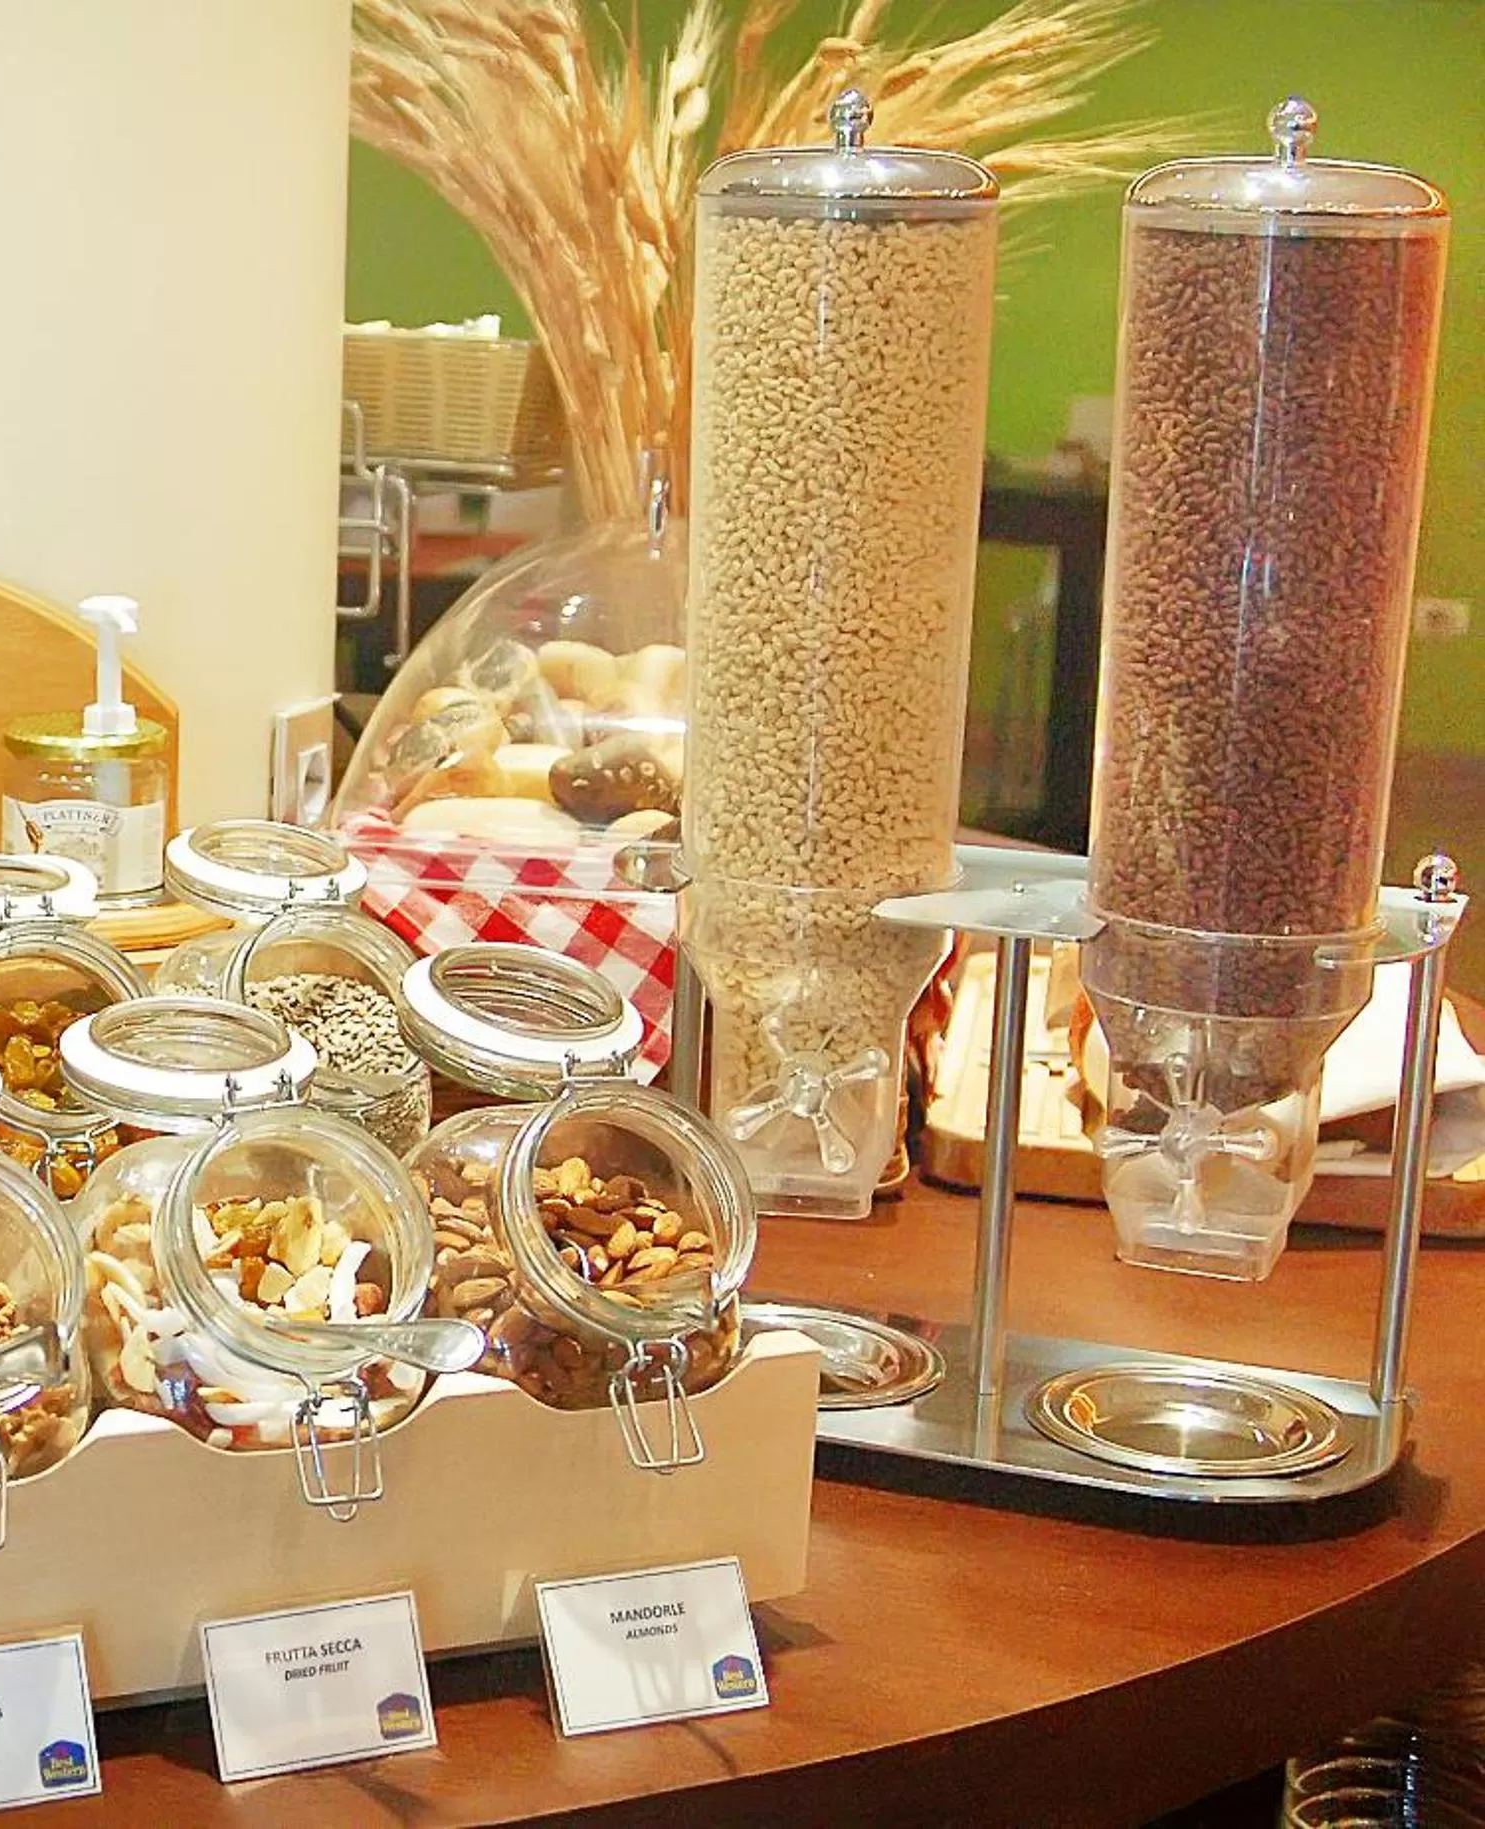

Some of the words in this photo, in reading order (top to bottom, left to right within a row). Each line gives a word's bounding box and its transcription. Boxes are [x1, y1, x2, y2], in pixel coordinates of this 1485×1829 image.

[44, 809, 111, 825] PLATTNER
[609, 1601, 687, 1624] MANDORLE
[625, 1624, 679, 1640] ALMONDS
[265, 1646, 318, 1665] FRUTTA
[320, 1638, 363, 1657] SECCA
[284, 1666, 317, 1682] DRIED
[318, 1660, 350, 1676] FRUIT
